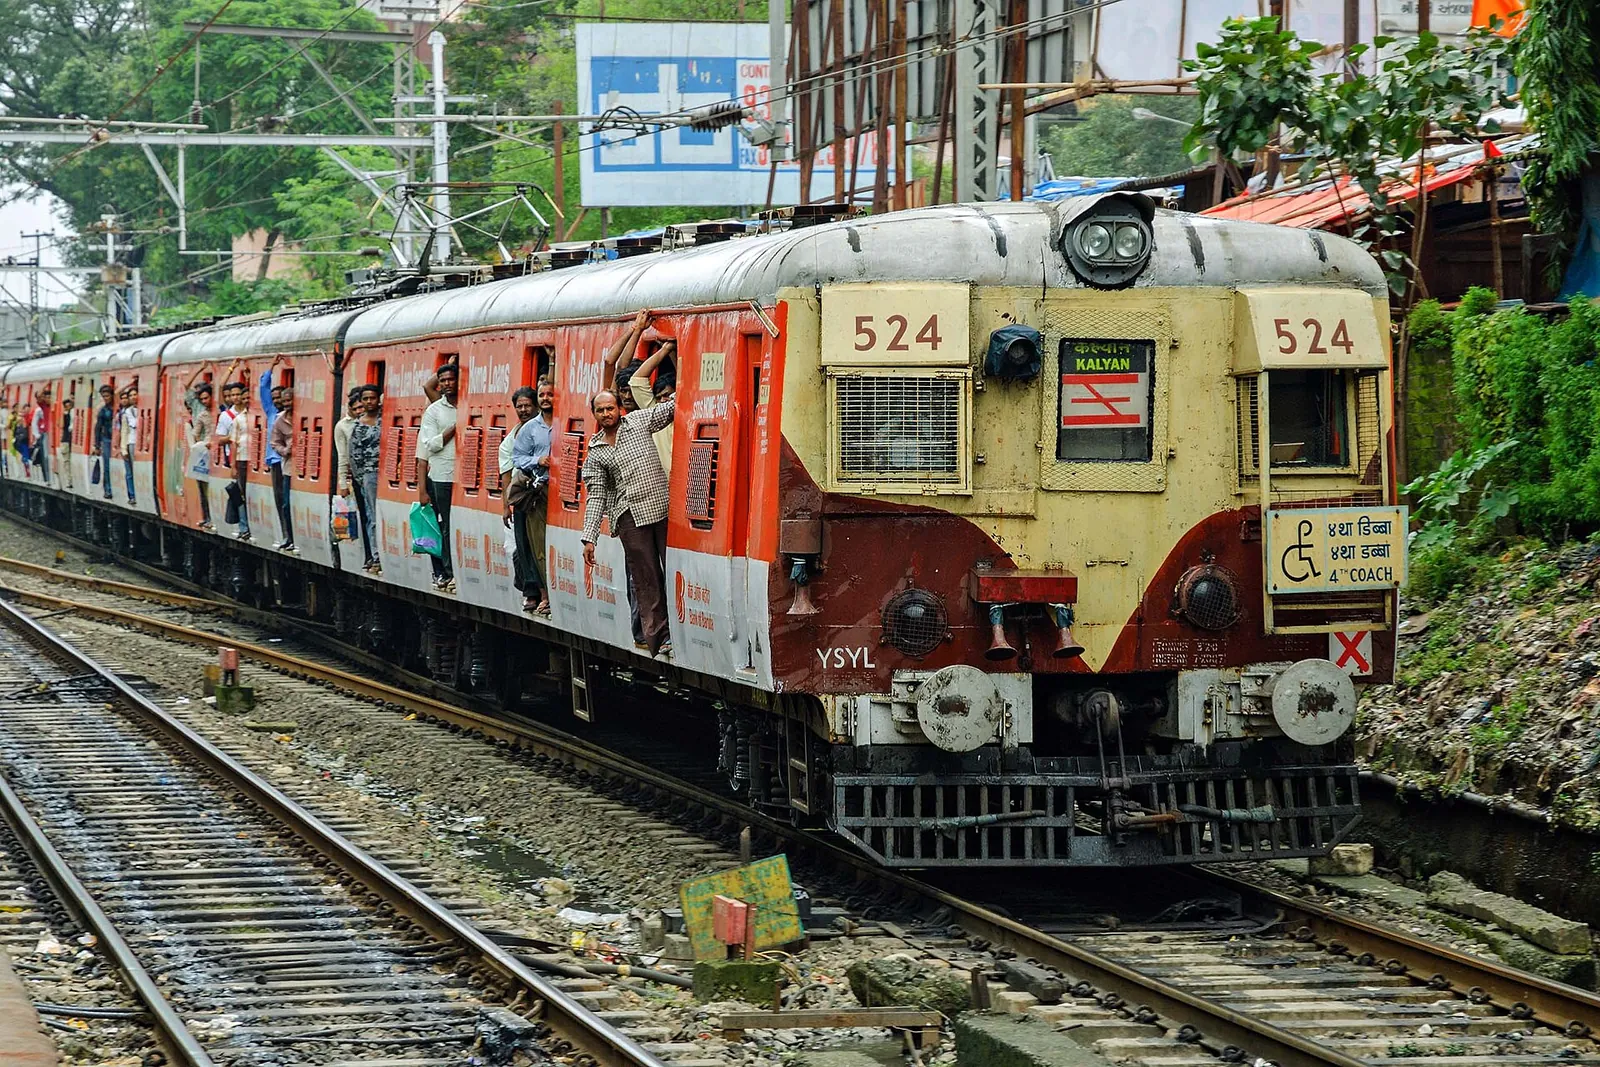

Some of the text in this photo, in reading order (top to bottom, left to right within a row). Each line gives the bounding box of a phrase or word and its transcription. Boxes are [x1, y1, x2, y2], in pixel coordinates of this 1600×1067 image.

[740, 148, 757, 165] FAX
[854, 314, 943, 351] 524
[1273, 318, 1354, 354] 524
[468, 355, 510, 394] Home Loans
[569, 349, 576, 393] 6
[576, 348, 599, 406] days
[1076, 358, 1130, 371] KALYAN
[1350, 566, 1392, 582] COACH
[816, 647, 876, 669] YSYL
